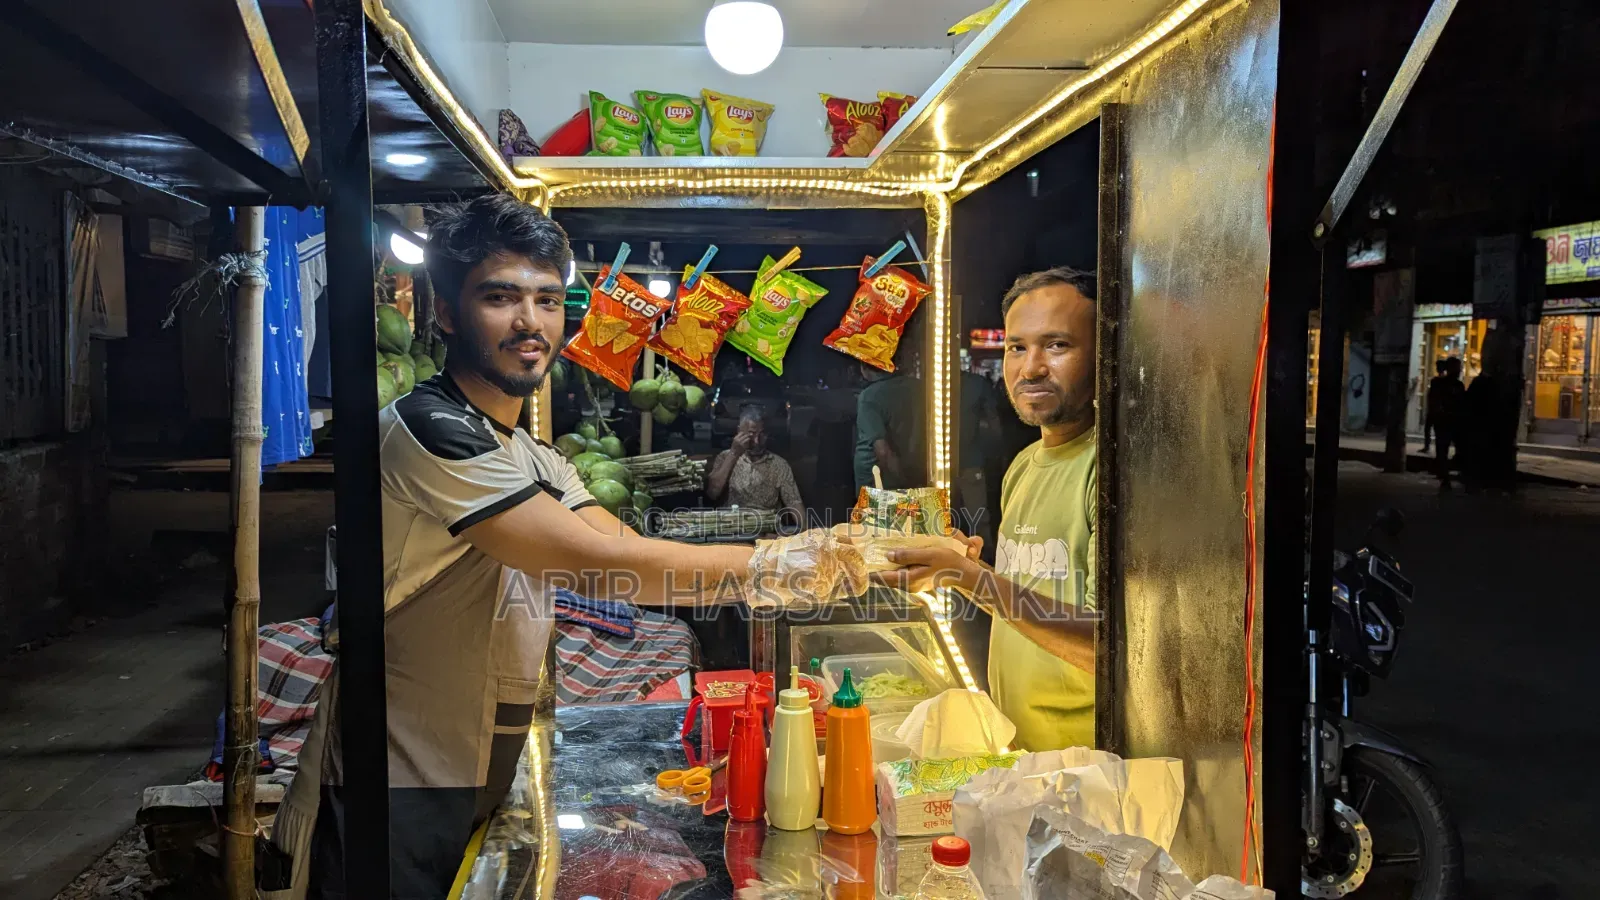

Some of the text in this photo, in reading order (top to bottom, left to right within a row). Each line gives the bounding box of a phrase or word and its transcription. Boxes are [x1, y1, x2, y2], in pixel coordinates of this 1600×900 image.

[667, 107, 692, 118] Lay's
[728, 105, 753, 120] Lay's
[922, 799, 953, 817] বসুন্ধ
